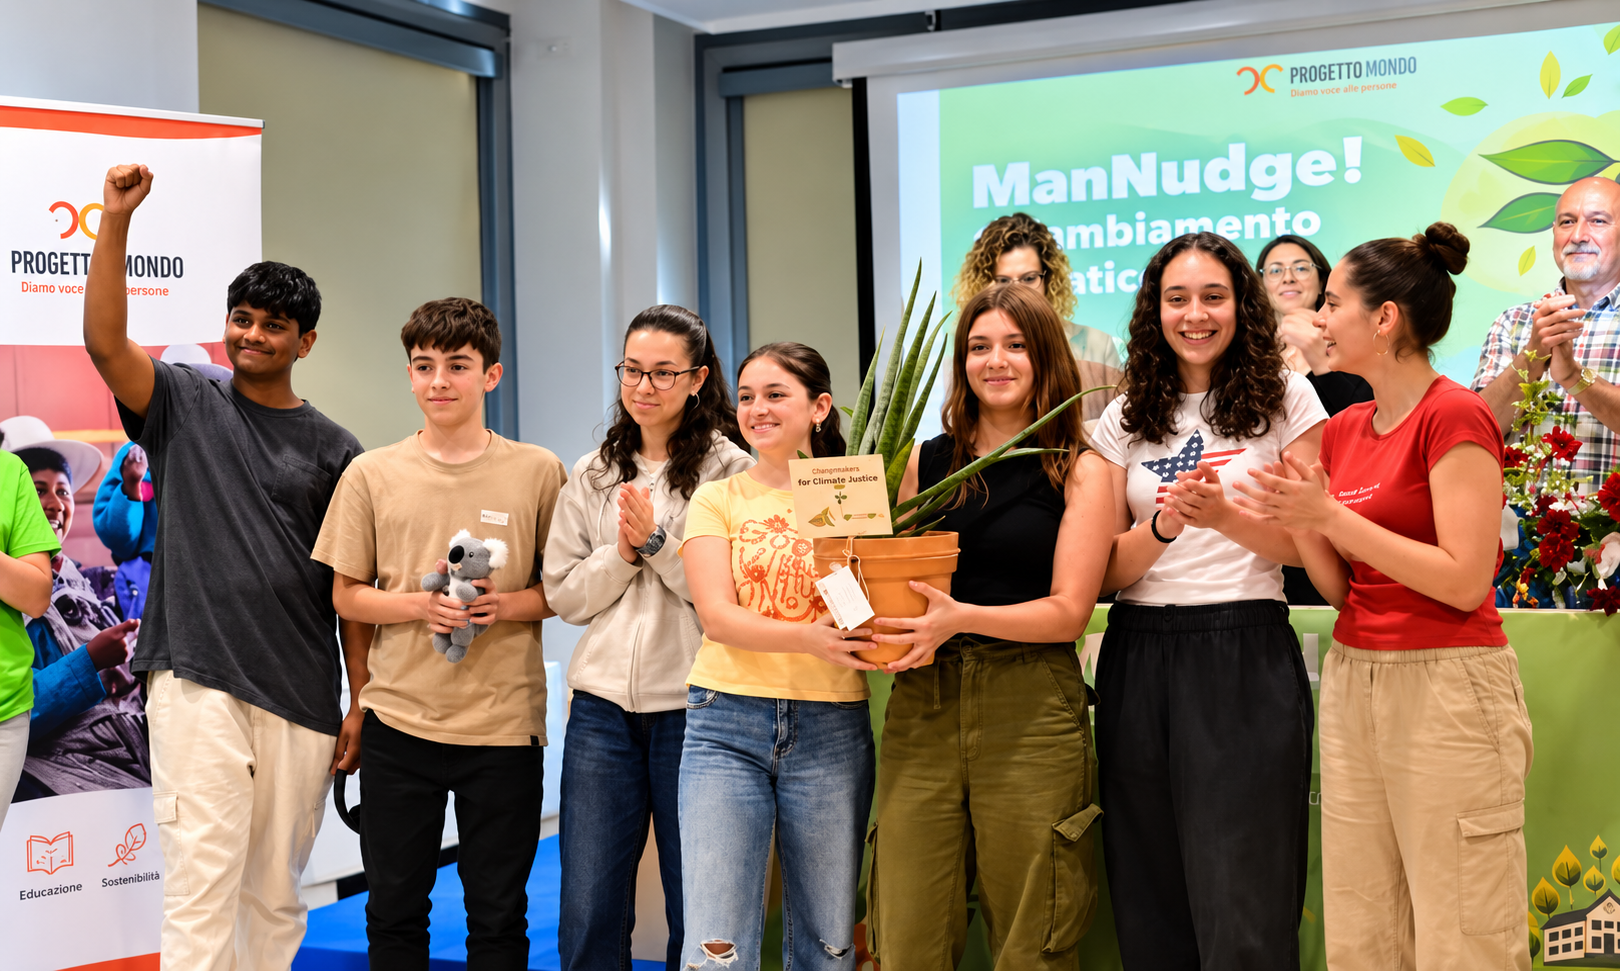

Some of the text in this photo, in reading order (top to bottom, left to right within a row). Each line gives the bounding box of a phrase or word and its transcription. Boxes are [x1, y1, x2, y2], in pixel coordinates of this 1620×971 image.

[1290, 57, 1417, 84] PROGETTO MONDO
[1291, 83, 1397, 97] Diamo voce alle persone
[972, 136, 1363, 209] ManNudge!
[1034, 206, 1322, 250] ambiamento
[11, 250, 92, 276] PROGETT
[21, 281, 56, 294] Diamo
[58, 284, 84, 294] voce
[798, 474, 878, 486] for Climate Justice
[101, 871, 160, 888] Sostenibilità
[19, 883, 83, 901] Educazione
